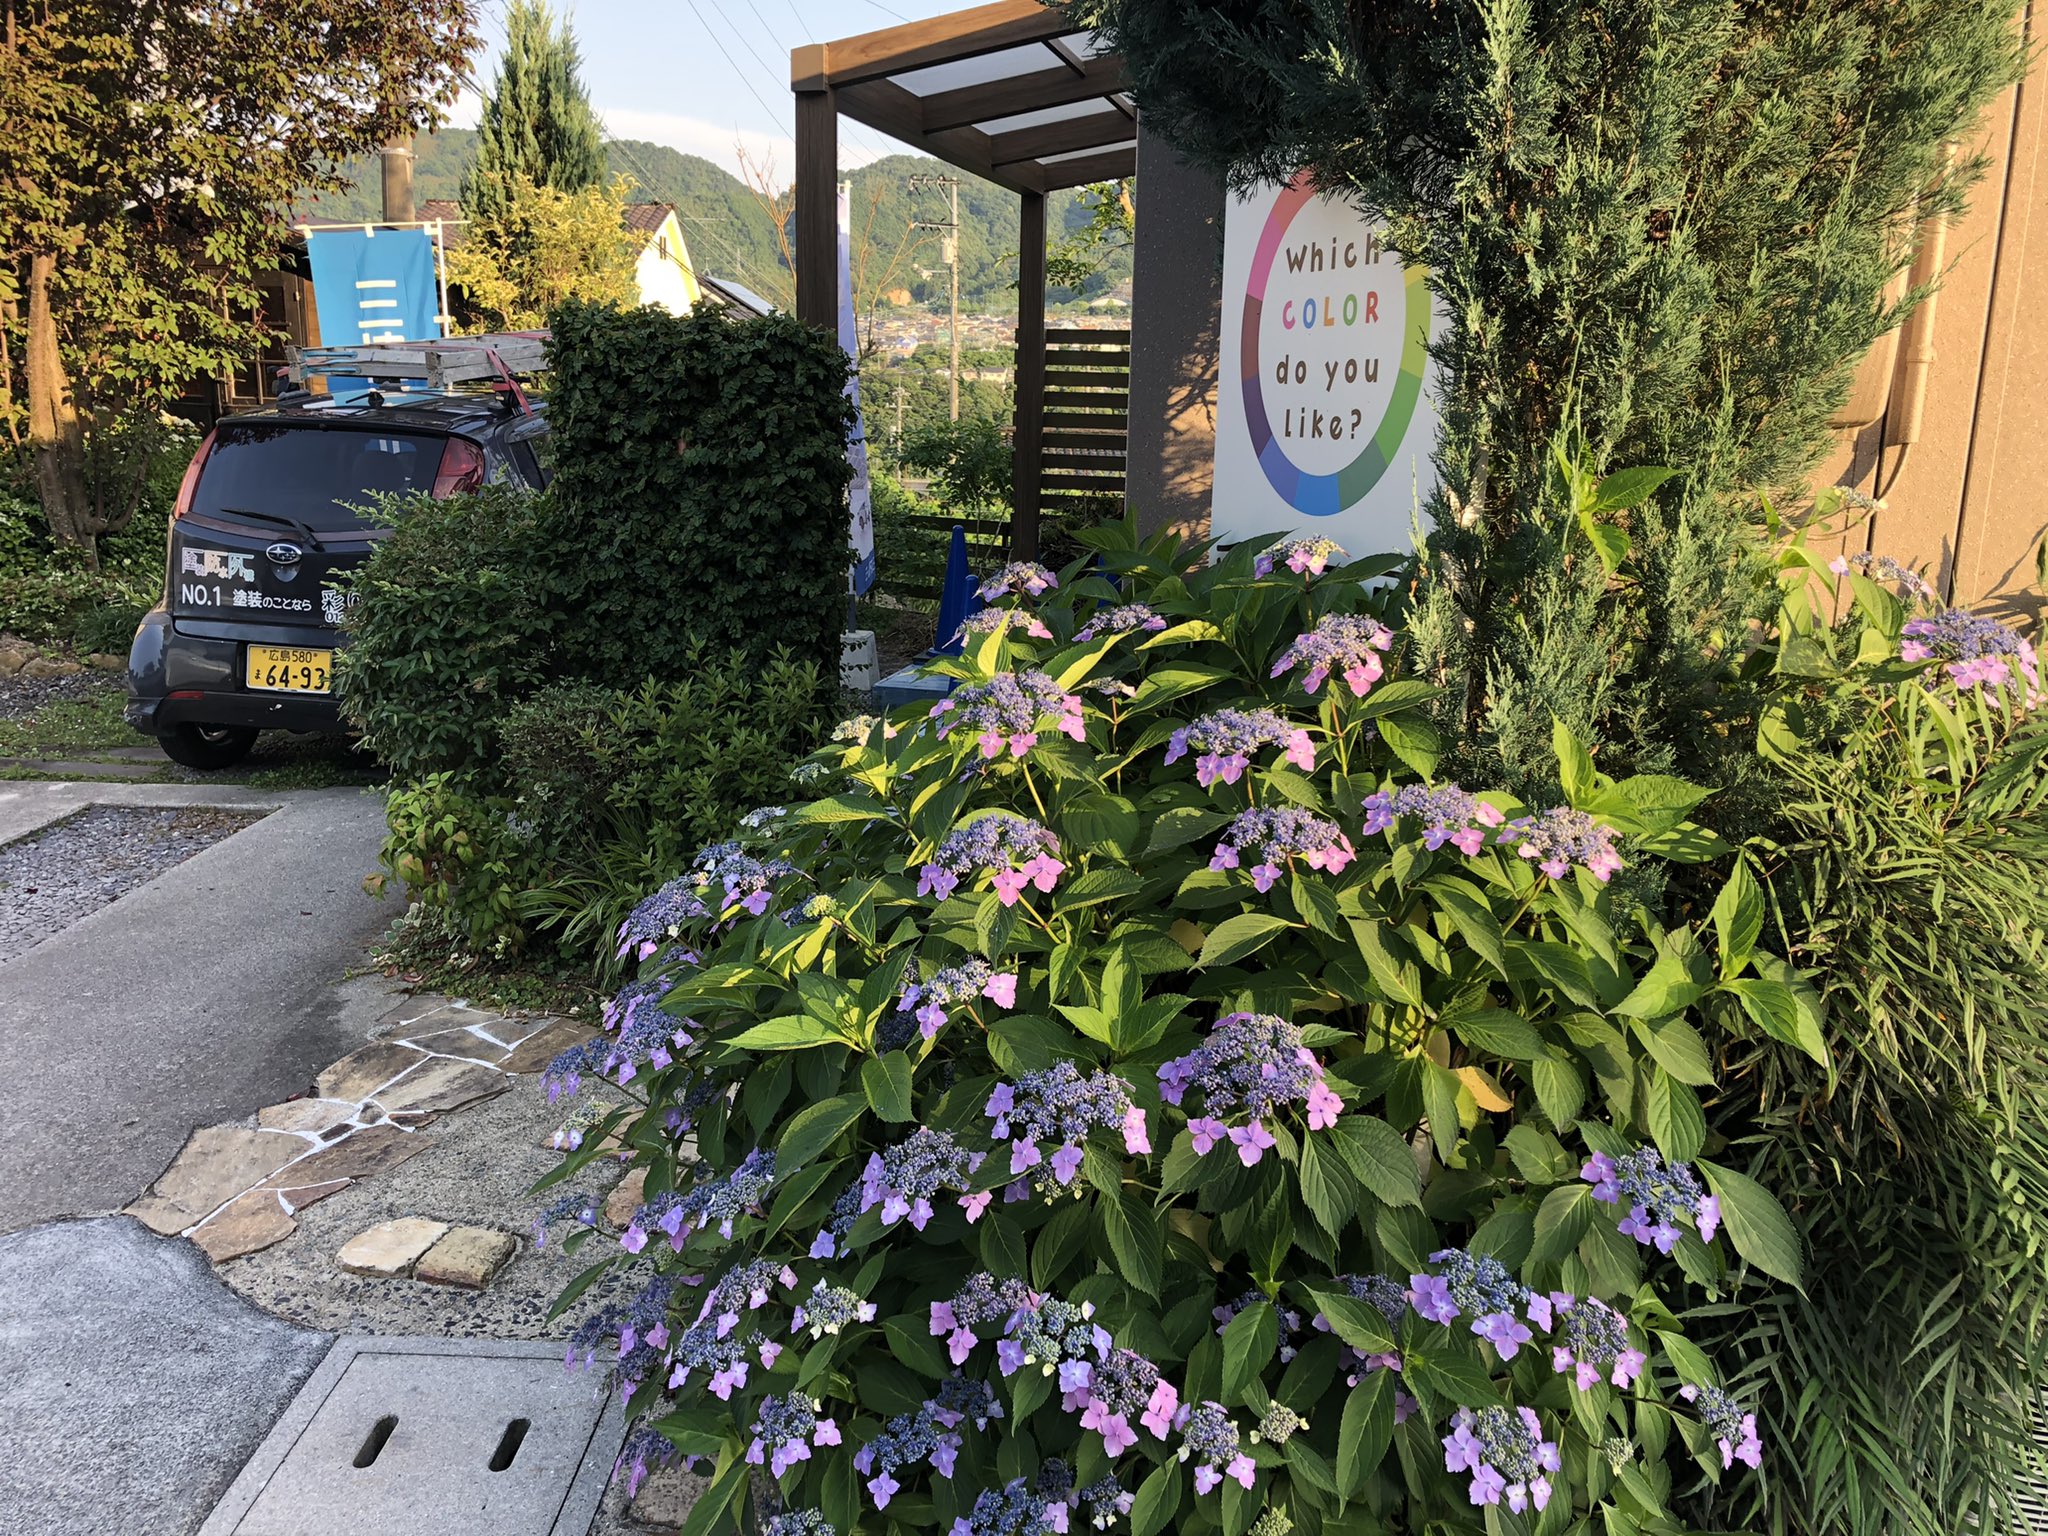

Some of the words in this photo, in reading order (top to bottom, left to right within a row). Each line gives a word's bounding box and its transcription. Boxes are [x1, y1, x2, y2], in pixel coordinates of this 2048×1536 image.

[1282, 290, 1379, 330] COLOR
[1276, 354, 1307, 385] do
[1325, 356, 1379, 392] you
[1284, 408, 1363, 441] like?
[182, 584, 221, 607] NO.1
[232, 588, 312, 612] 塗装のことなら
